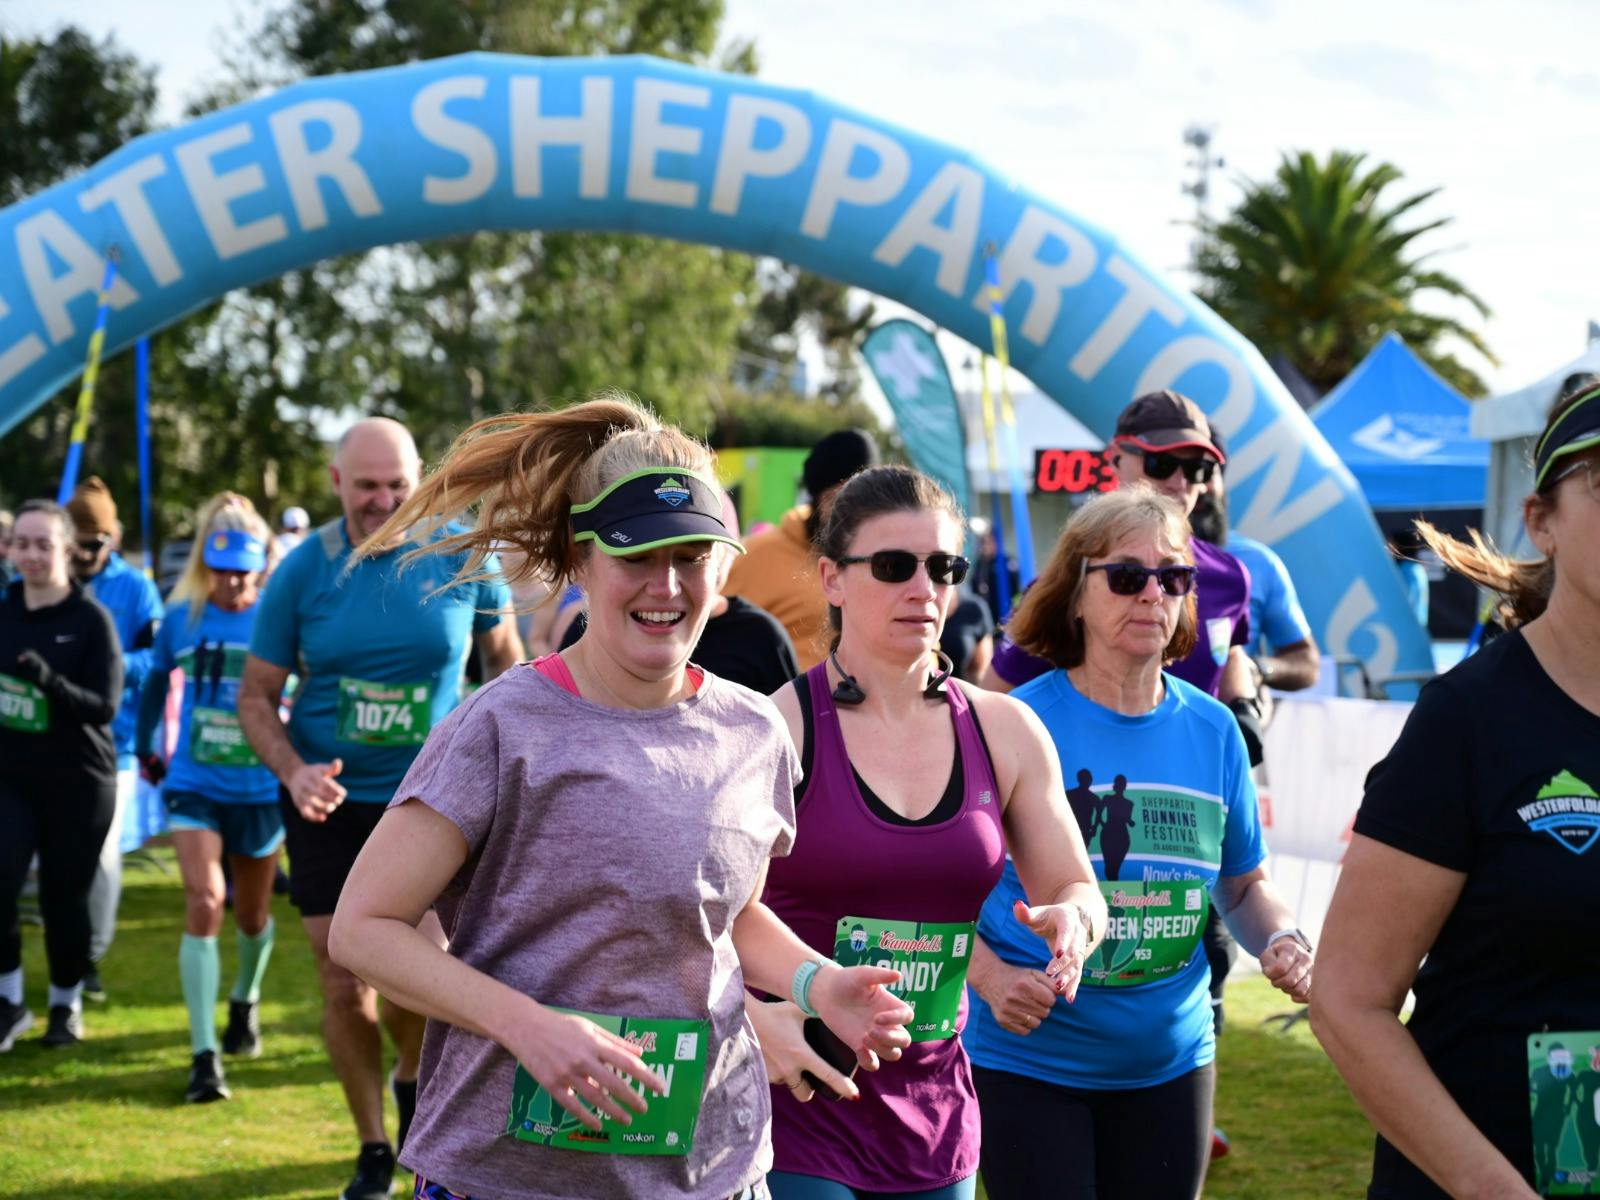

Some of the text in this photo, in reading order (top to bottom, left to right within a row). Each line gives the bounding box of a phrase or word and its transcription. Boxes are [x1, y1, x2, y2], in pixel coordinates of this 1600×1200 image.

[411, 74, 1345, 547] SHEPPARTON
[355, 701, 413, 732] 1074
[1142, 797, 1196, 811] SHEPPARTON
[1142, 809, 1197, 828] RUNNING
[1144, 825, 1200, 845] FESTIVAL
[1143, 865, 1181, 881] Now's
[1112, 890, 1171, 909] Campbell's
[1104, 914, 1201, 941] REN SPEEDY
[880, 930, 942, 954] Campbell's
[1135, 948, 1152, 961] 953
